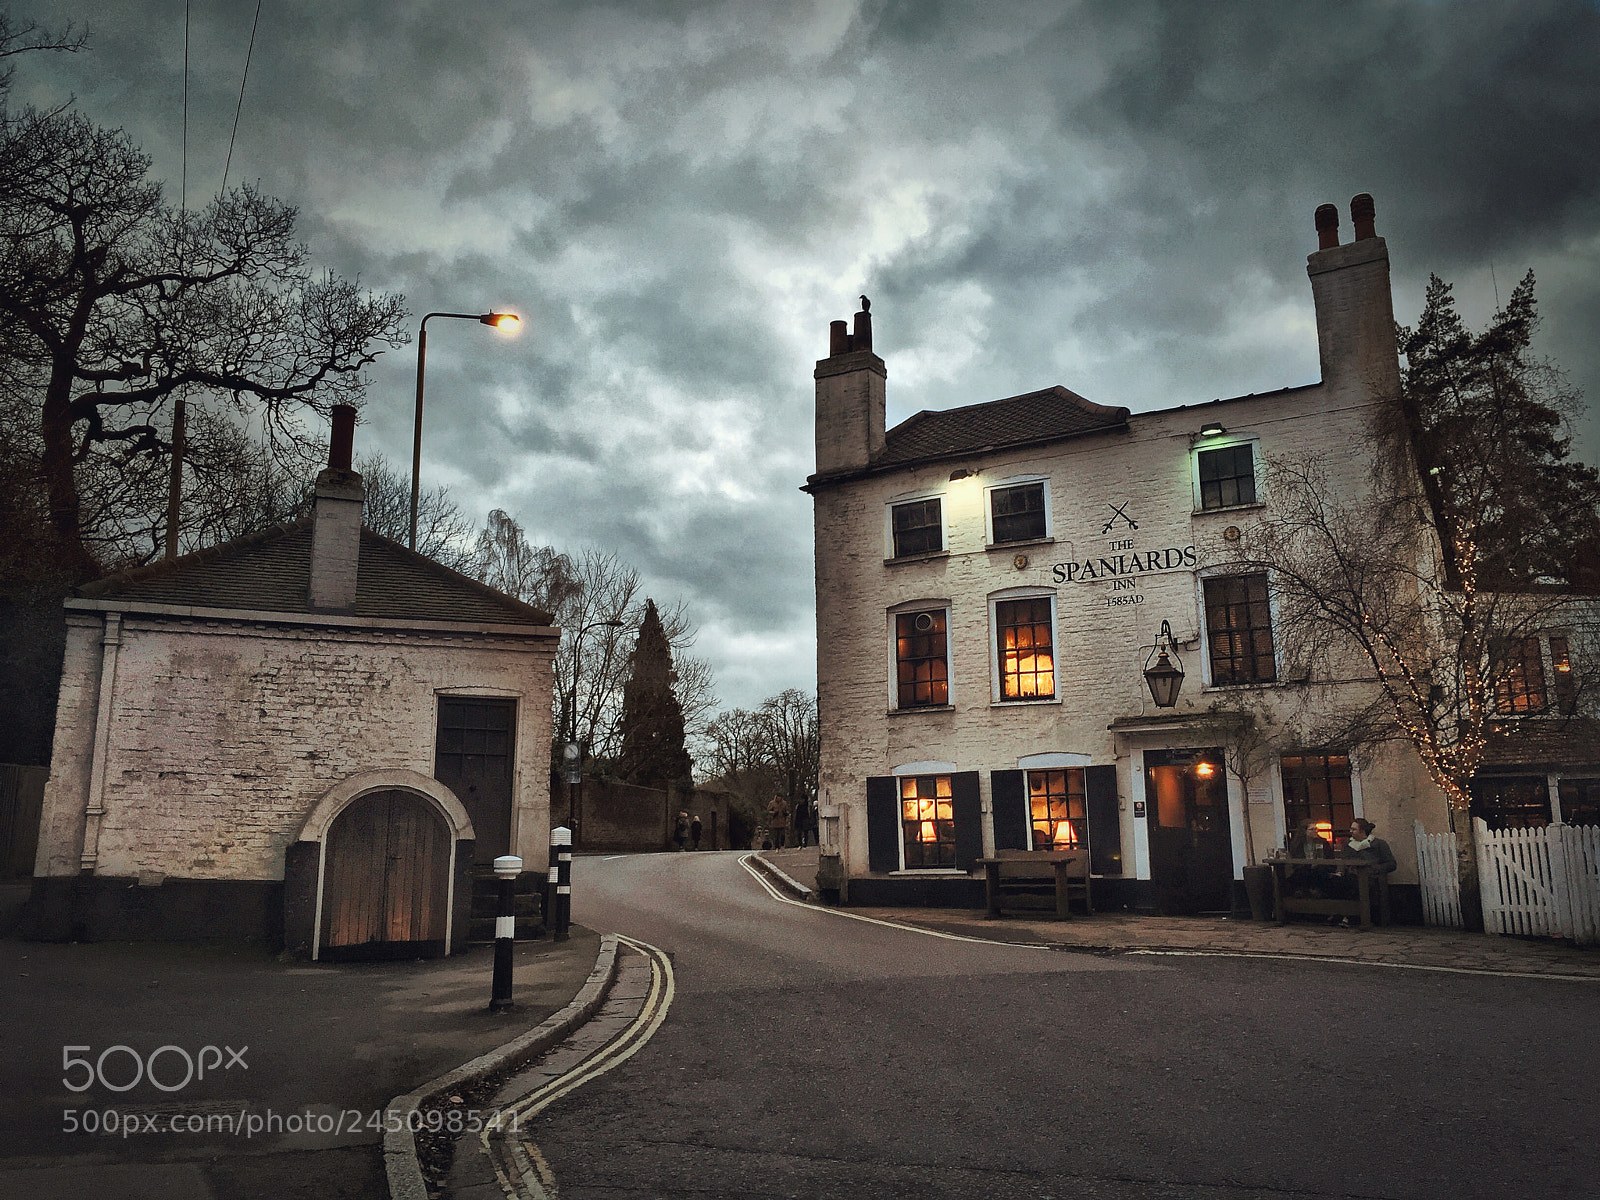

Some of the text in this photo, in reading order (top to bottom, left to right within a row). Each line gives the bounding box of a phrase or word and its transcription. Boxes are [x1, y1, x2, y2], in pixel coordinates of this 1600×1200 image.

[1109, 539, 1134, 550] THE
[1053, 546, 1197, 583] SPANIARDS
[1112, 578, 1136, 590] INN
[1107, 594, 1144, 606] 1585AD
